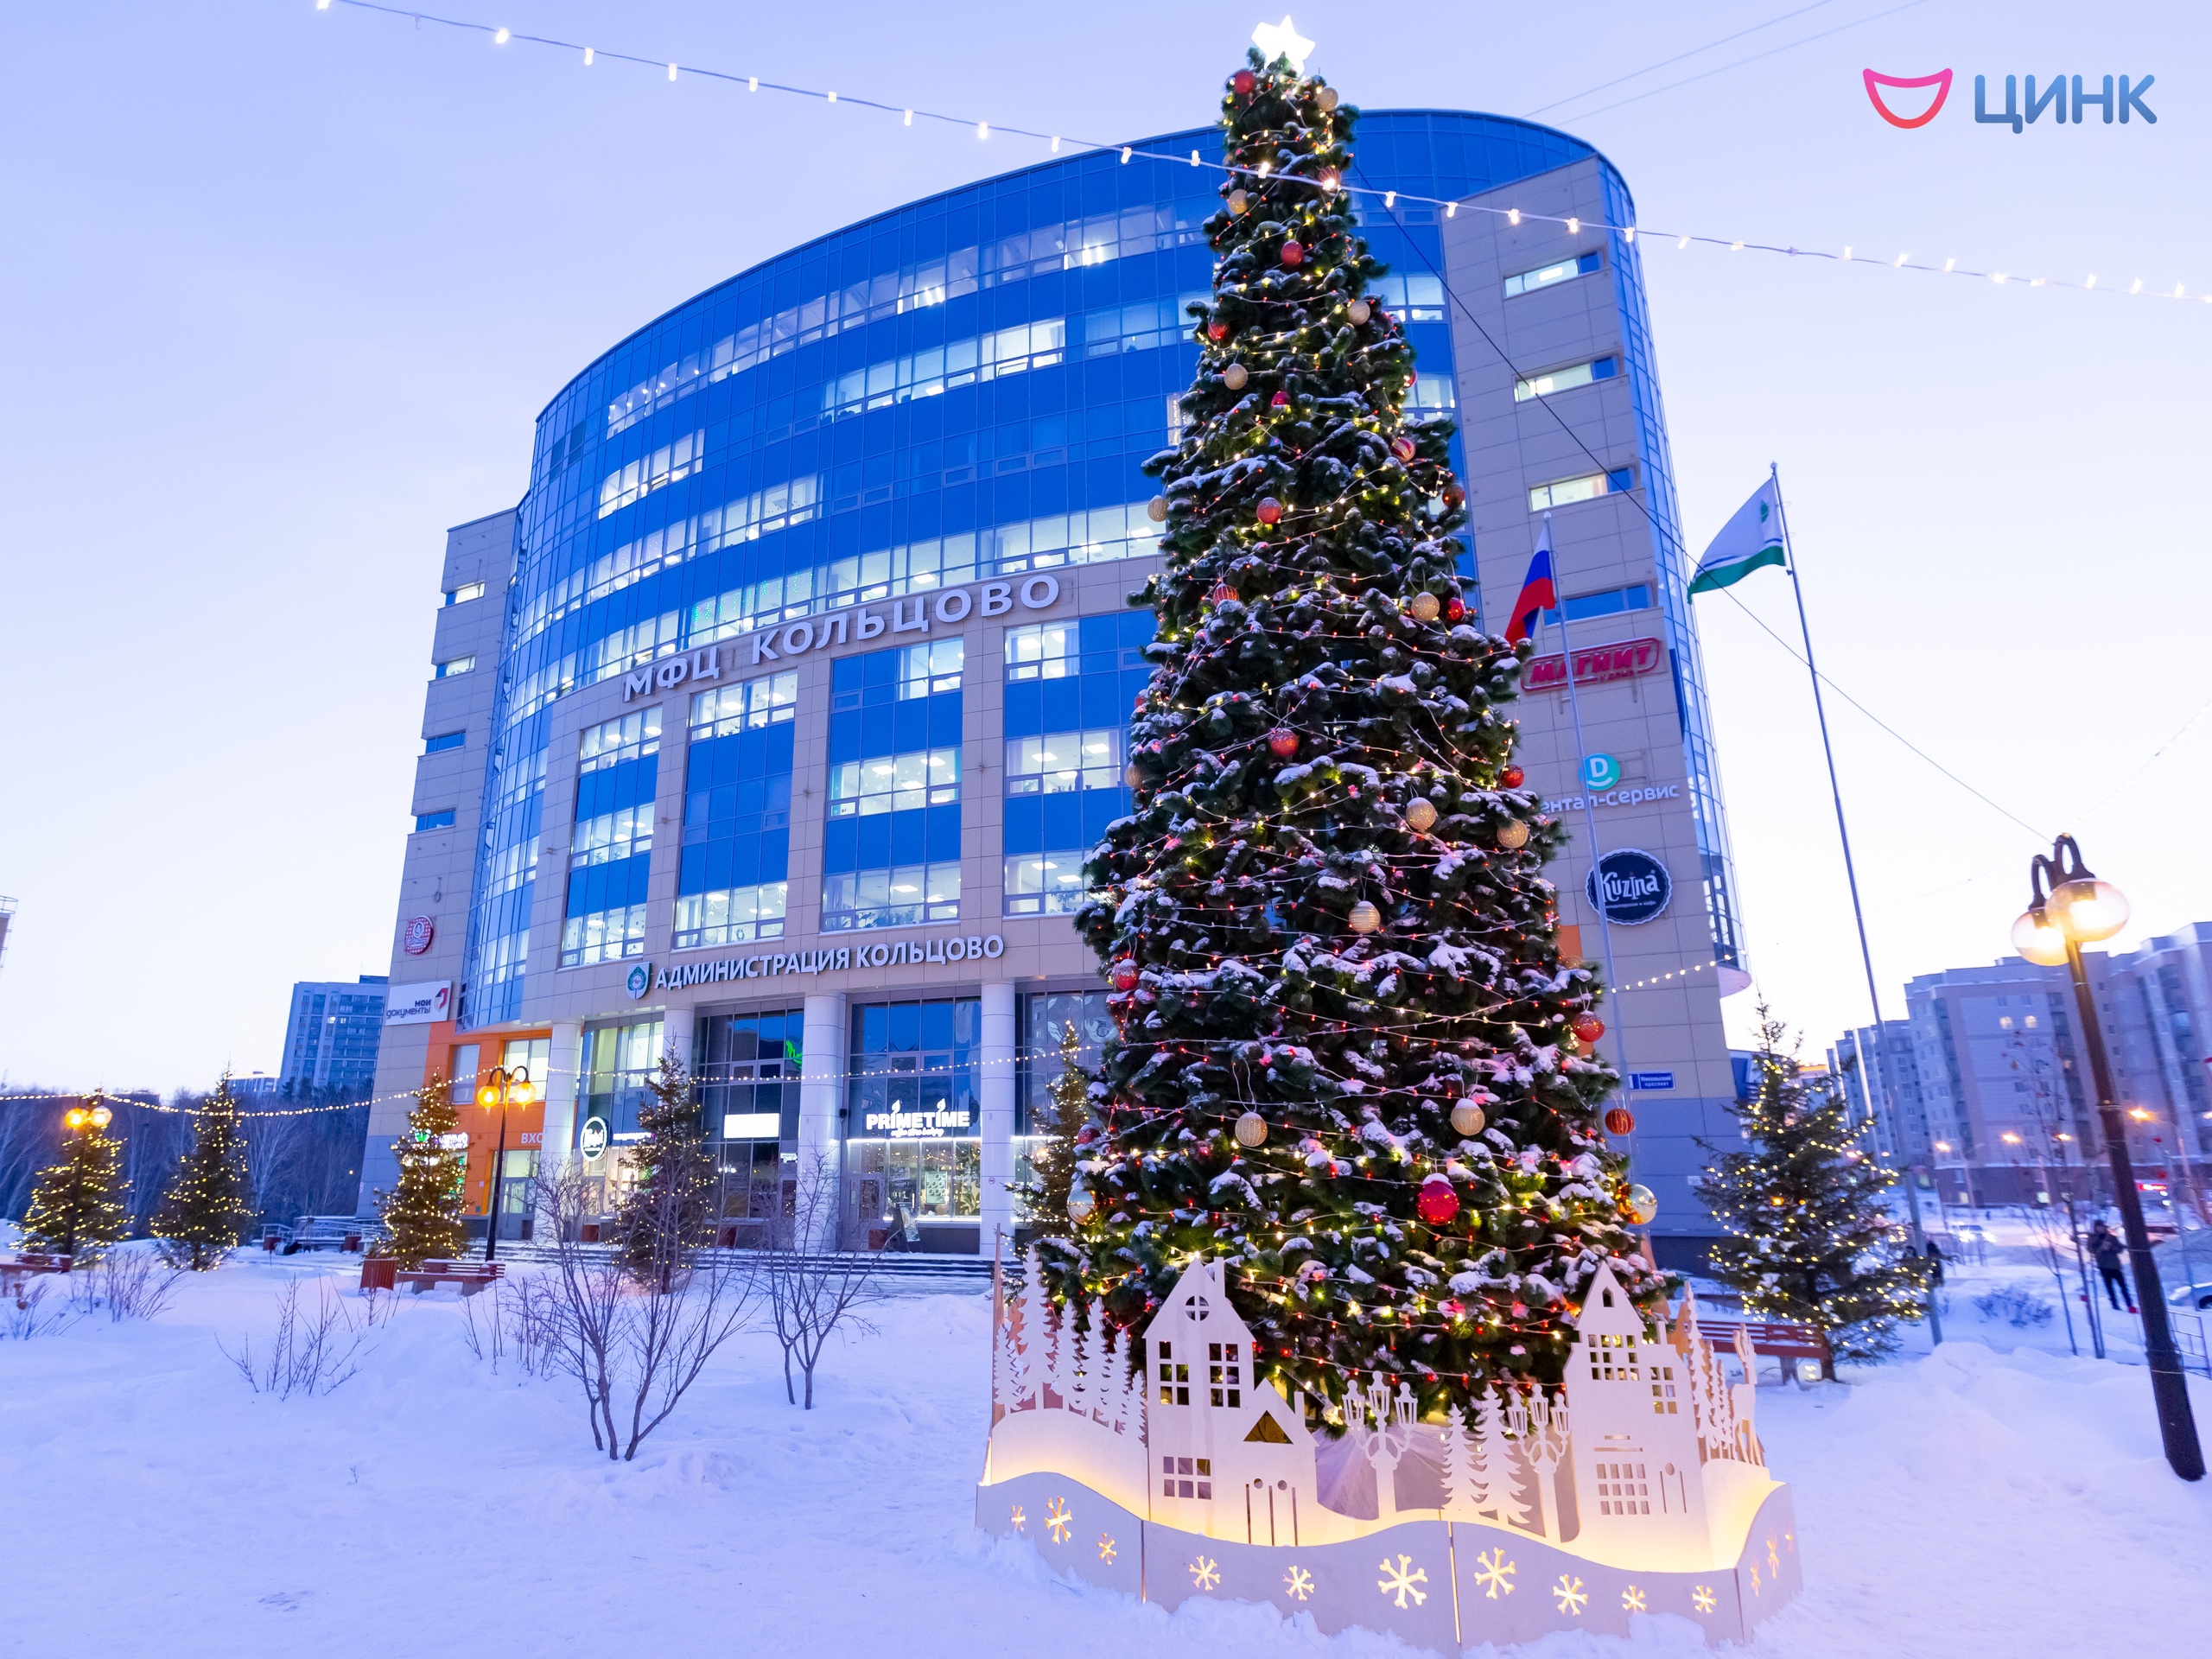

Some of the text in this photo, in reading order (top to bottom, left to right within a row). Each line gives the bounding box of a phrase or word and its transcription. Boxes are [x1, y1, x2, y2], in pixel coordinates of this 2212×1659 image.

[623, 574, 1060, 702] МФЦ КОЛЬЦОВО
[1589, 757, 1609, 778] D
[1541, 785, 1680, 814] ентал-Сервис
[1600, 871, 1661, 902] Kuzina
[654, 934, 1005, 991] АДМИНИСТРАЦИЯ КОЛЬЦОВО
[866, 1103, 970, 1129] PRIMETIME
[521, 1132, 543, 1144] ВХО
